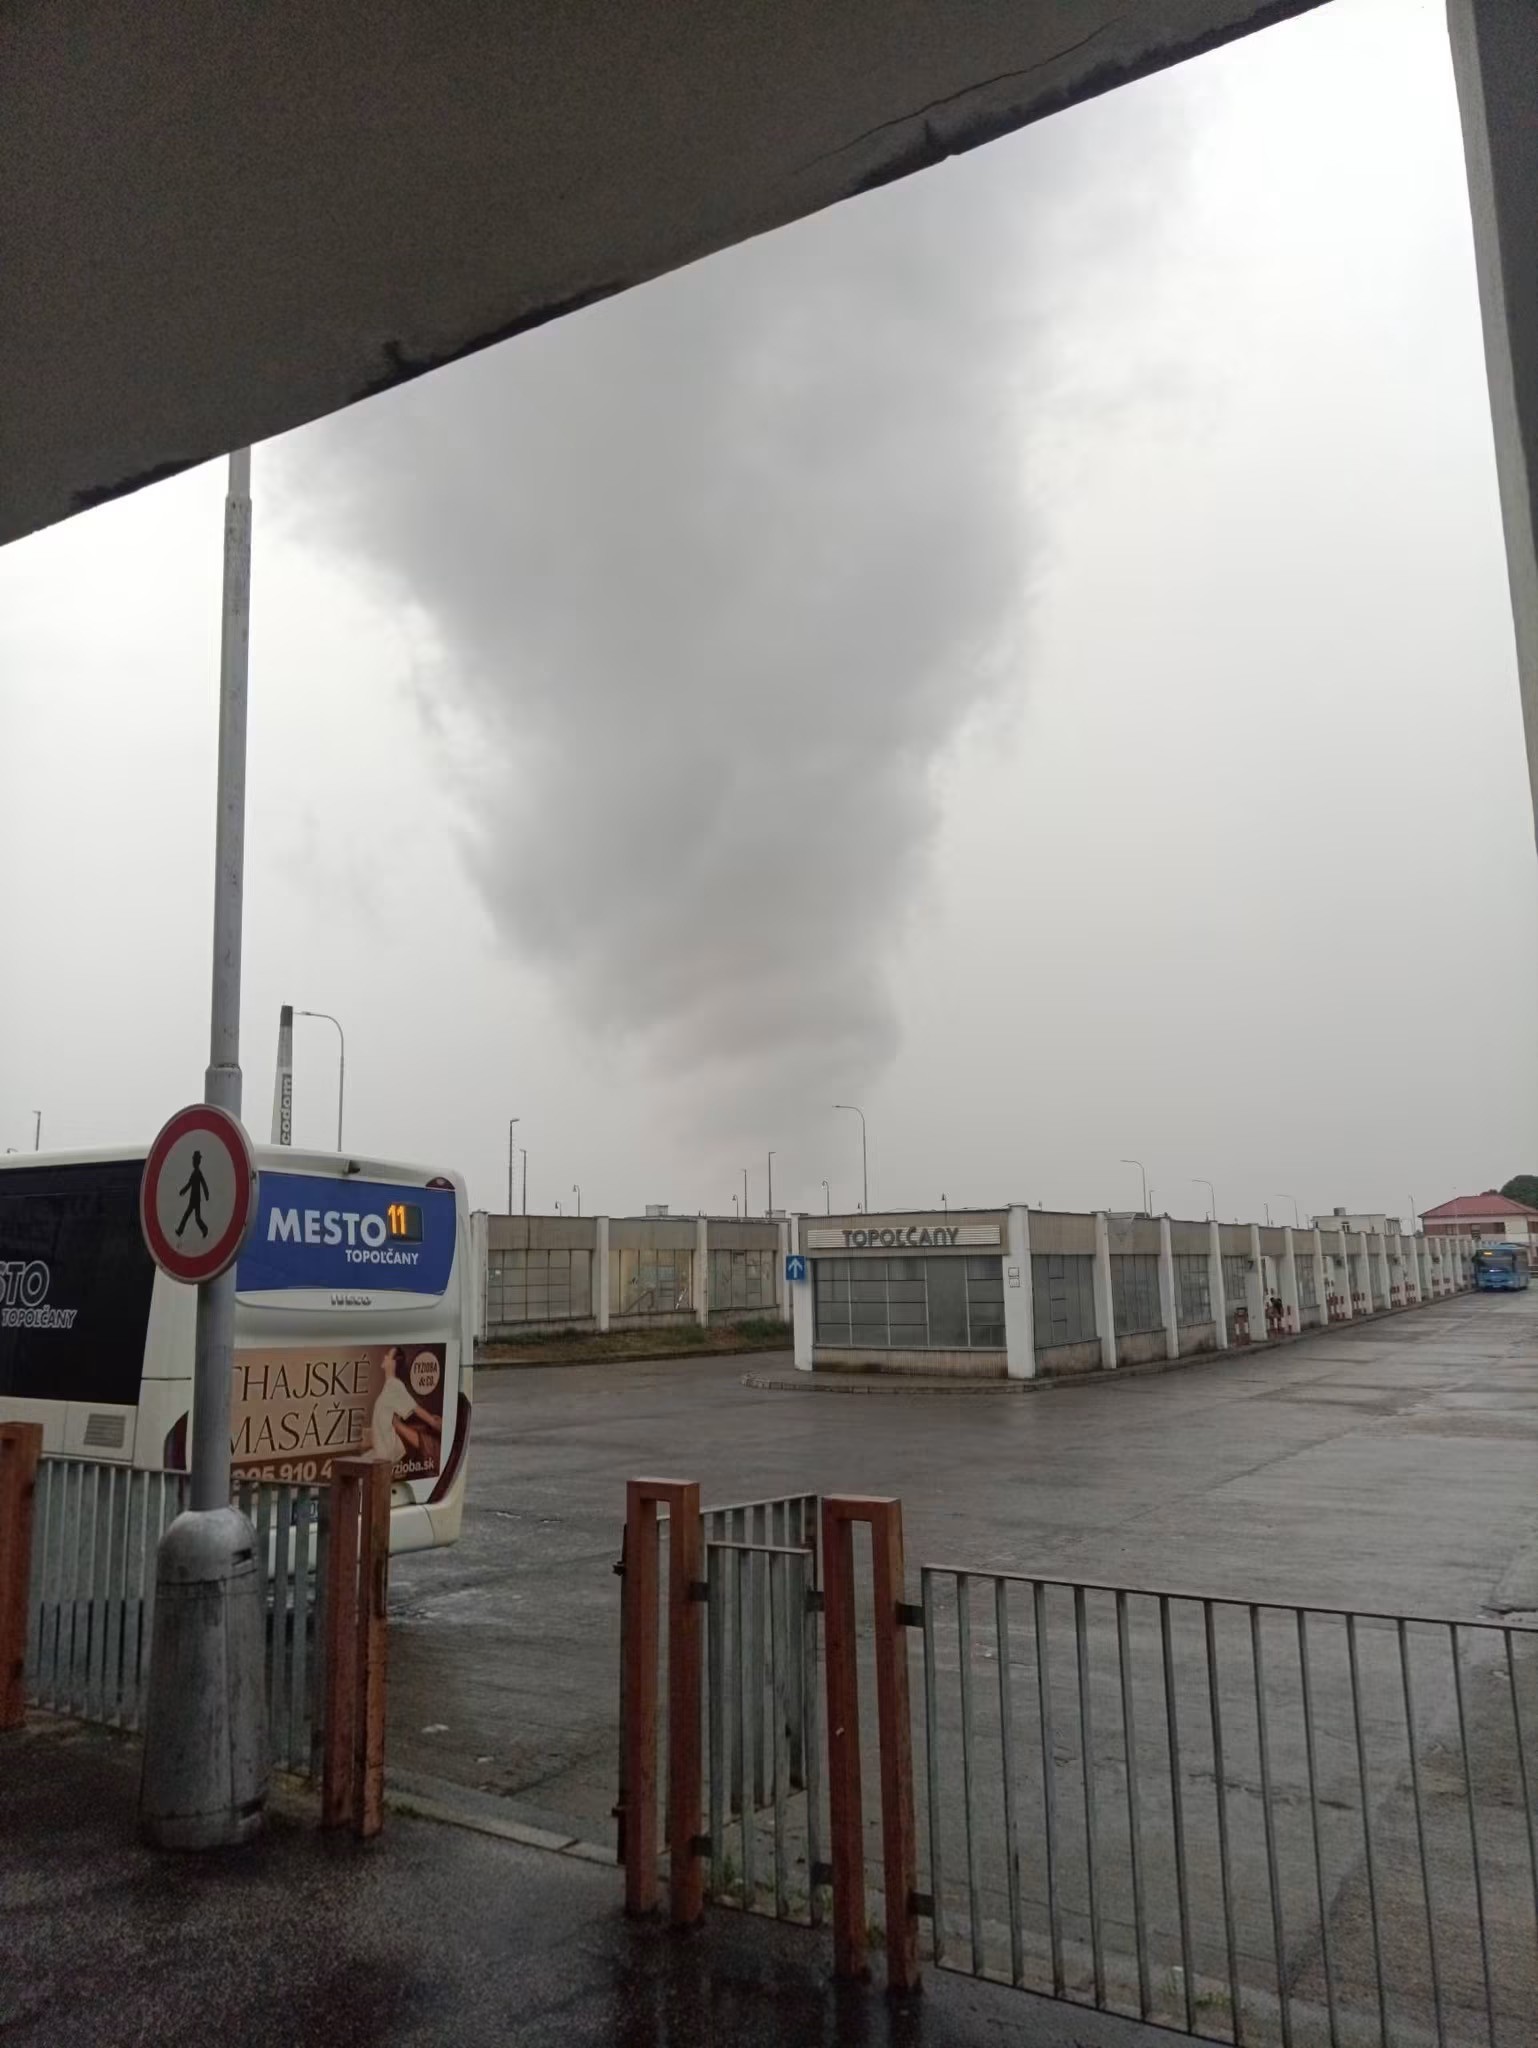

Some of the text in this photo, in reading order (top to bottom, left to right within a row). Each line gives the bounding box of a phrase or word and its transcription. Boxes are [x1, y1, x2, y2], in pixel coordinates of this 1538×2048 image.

[267, 1206, 387, 1247] MESTO
[388, 1204, 406, 1235] 11
[345, 1248, 419, 1265] TOPOĽČANY
[230, 1402, 365, 1456] MASÁŽE
[279, 1461, 317, 1482] 910
